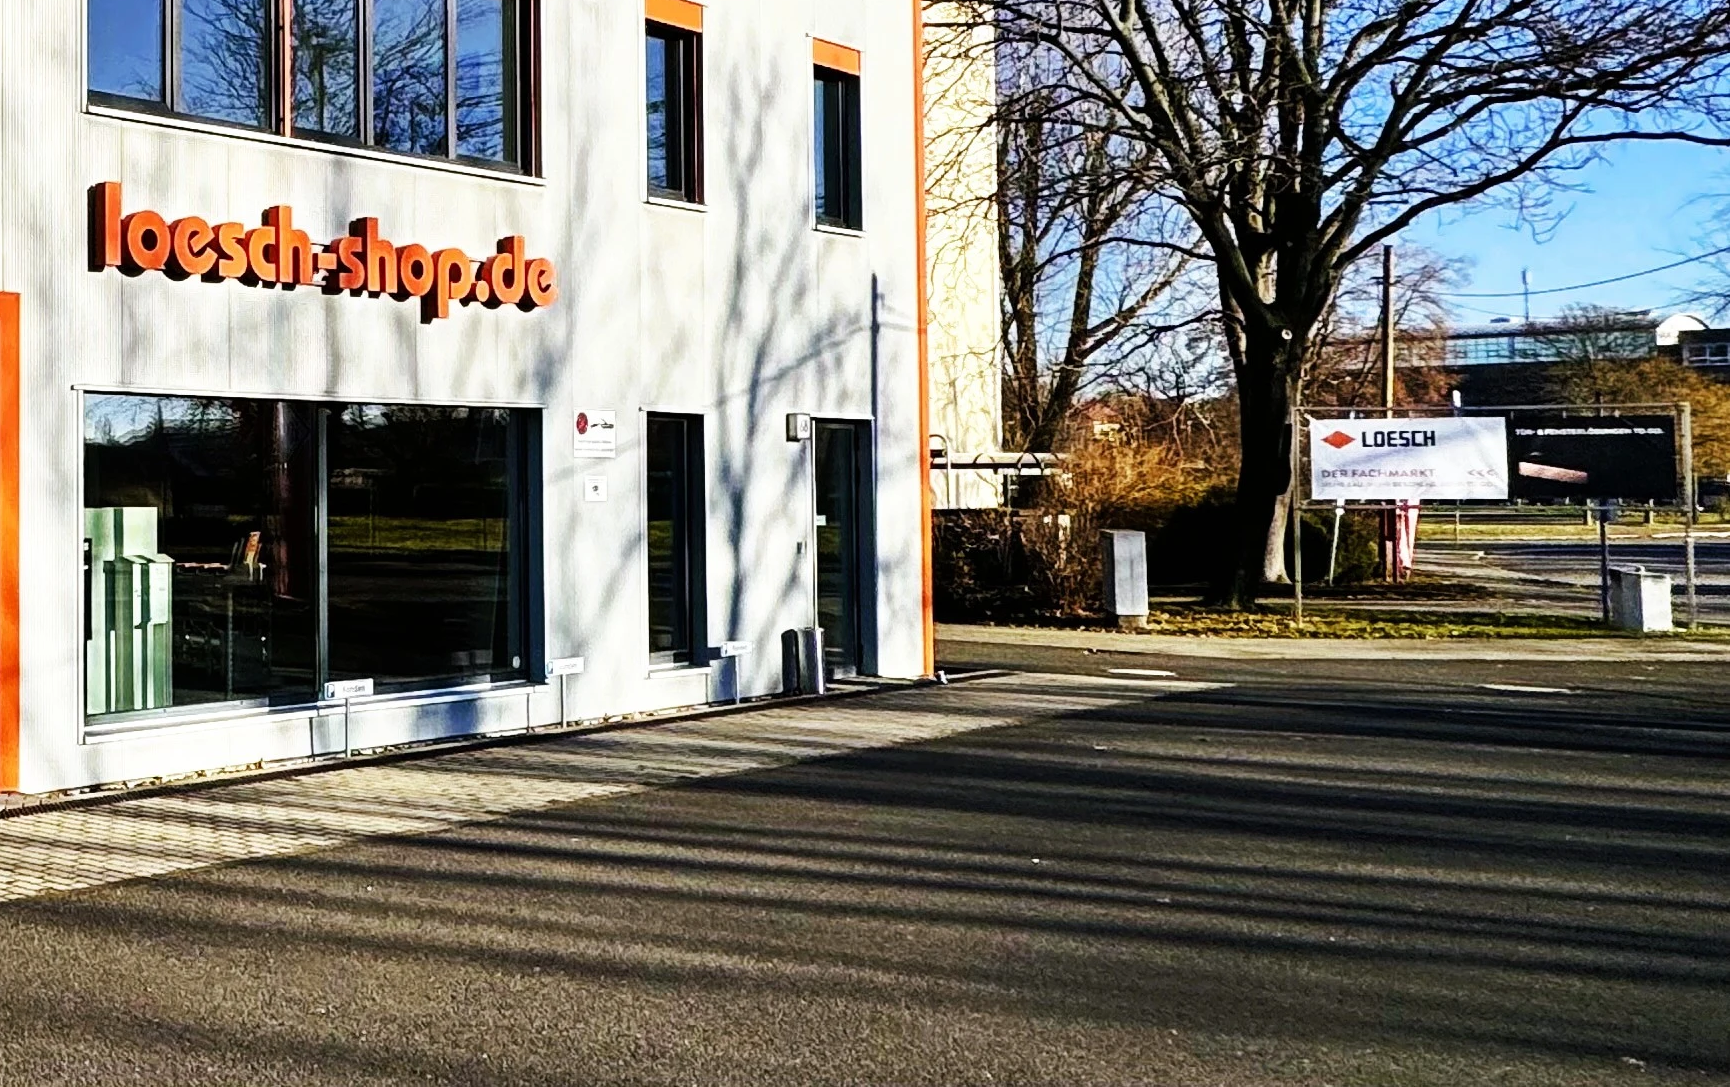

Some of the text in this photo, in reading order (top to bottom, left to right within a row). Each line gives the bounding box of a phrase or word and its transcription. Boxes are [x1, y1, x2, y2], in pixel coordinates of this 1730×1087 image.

[87, 181, 559, 325] loesch-shop.de
[1361, 430, 1437, 448] LOESCH
[1321, 469, 1436, 478] DER FACHMARKT
